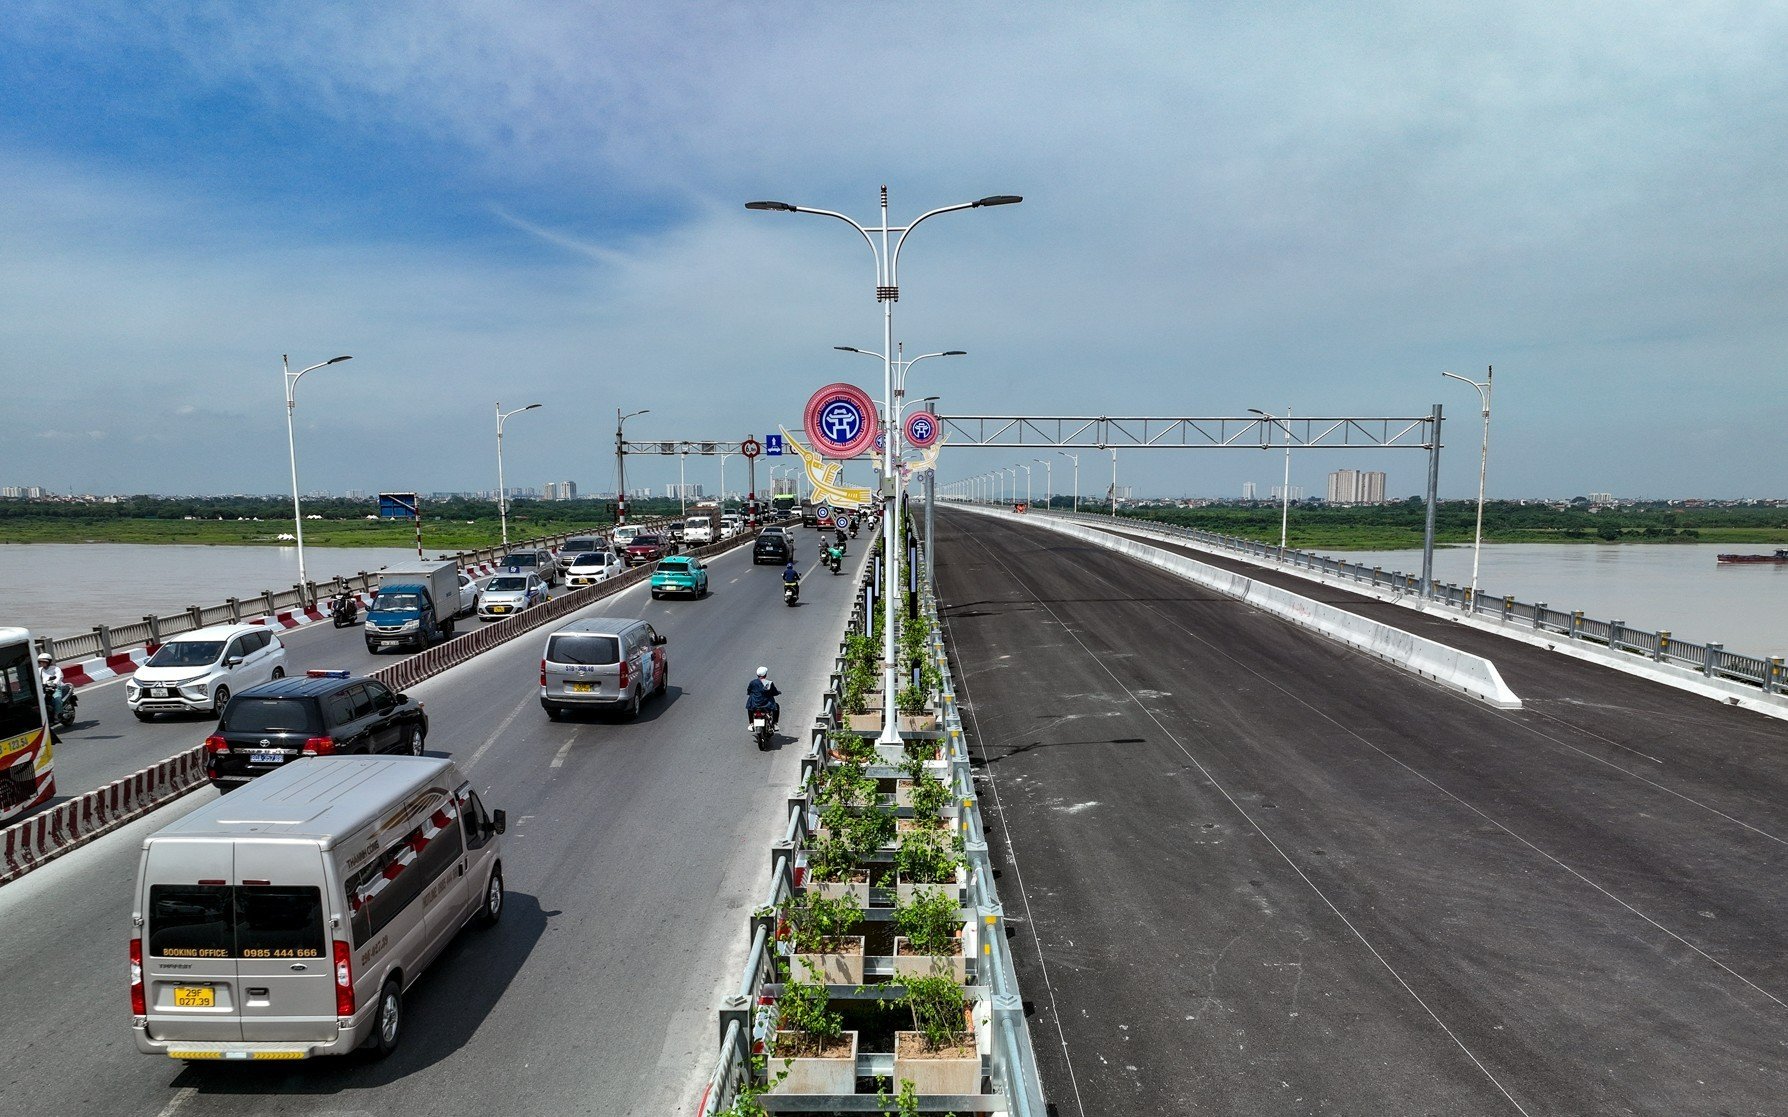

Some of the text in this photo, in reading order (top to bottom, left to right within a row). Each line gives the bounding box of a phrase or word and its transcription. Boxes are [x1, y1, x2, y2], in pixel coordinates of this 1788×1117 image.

[163, 948, 317, 957] BOOKING OFFICE: 0985 444 666
[185, 989, 202, 997] 29F
[179, 997, 210, 1006] 027.39
